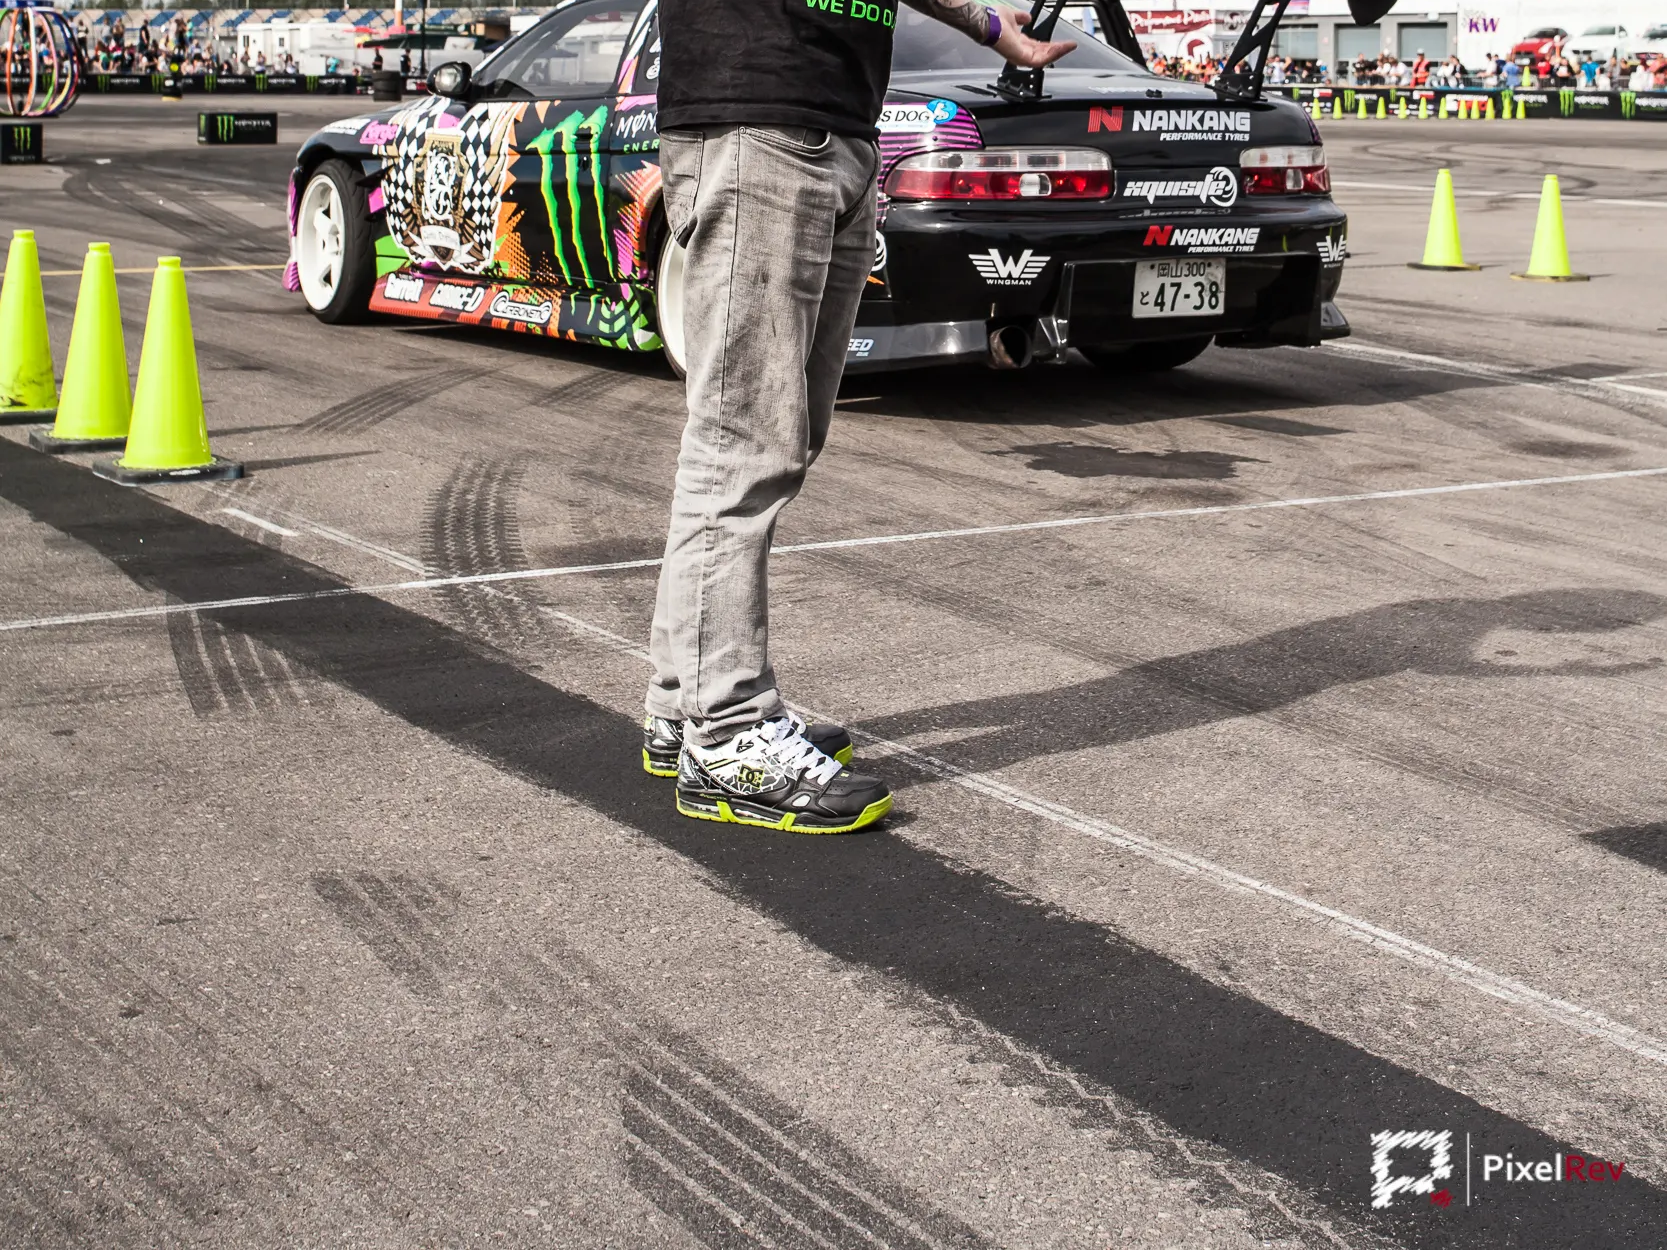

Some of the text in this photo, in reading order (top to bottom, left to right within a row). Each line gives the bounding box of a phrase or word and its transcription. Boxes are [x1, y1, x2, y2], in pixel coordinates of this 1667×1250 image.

[850, 0, 880, 22] DO
[1468, 17, 1499, 32] KW
[894, 110, 930, 122] DOG
[1132, 110, 1250, 131] NANKANG
[1160, 132, 1250, 141] PERFORMANCE TYRES
[1170, 228, 1260, 246] NANKANG
[986, 278, 1032, 286] WINGMAN
[1153, 280, 1219, 312] 47-38
